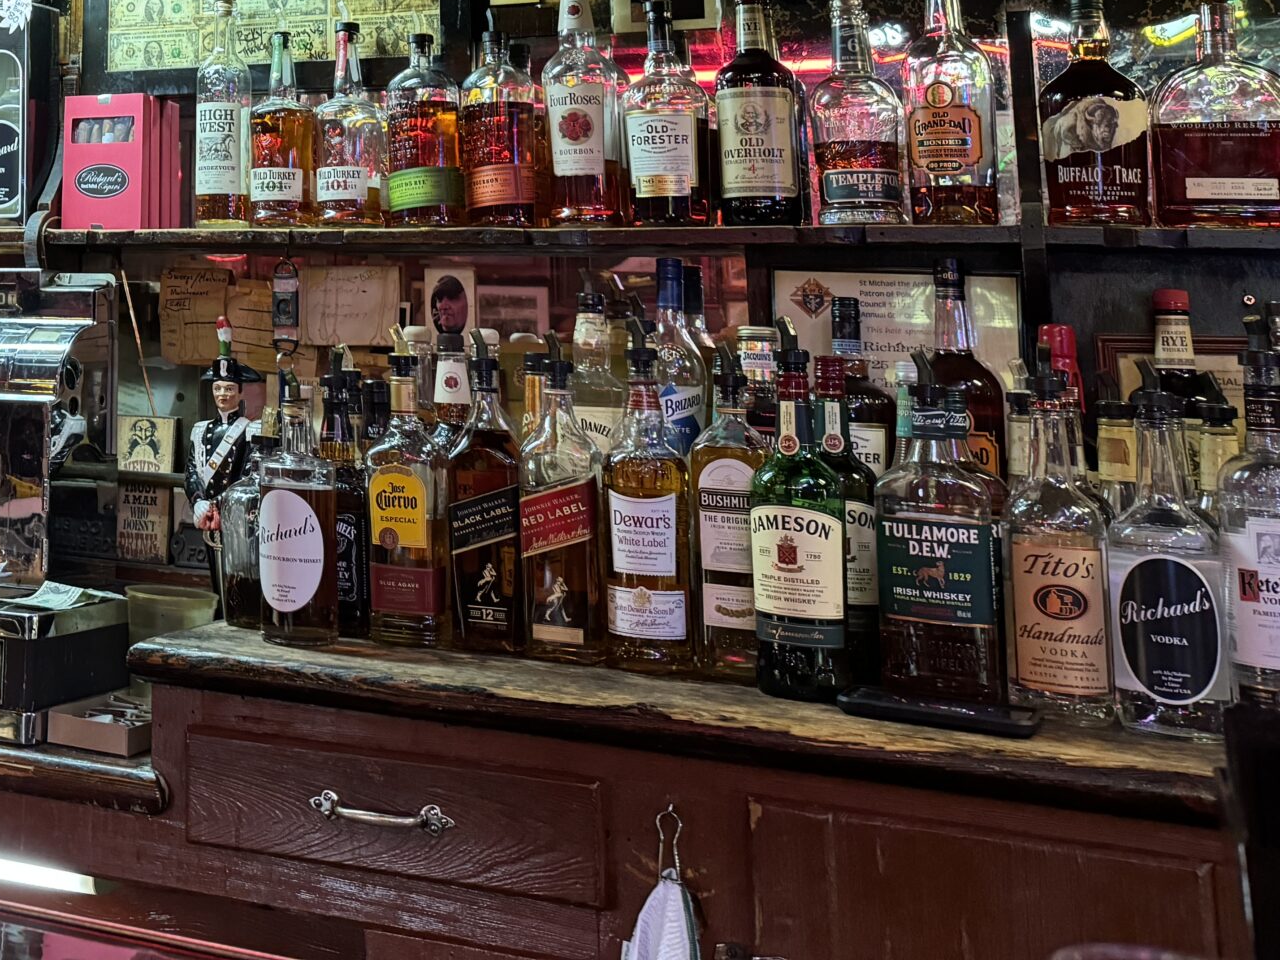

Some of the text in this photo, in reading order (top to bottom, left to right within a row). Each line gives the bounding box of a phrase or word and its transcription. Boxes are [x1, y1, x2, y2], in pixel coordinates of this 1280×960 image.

[549, 92, 601, 107] Four Roses
[200, 109, 235, 121] HIGH
[200, 122, 235, 133] WEST
[646, 124, 669, 134] OLD
[1171, 121, 1231, 130] WOODFORD
[632, 134, 689, 145] FORESTER
[740, 137, 764, 147] OLD
[923, 138, 962, 147] BONDED
[559, 148, 594, 156] BOURBON
[724, 147, 785, 159] OVERHOLT
[267, 169, 296, 180] TURKEY
[332, 168, 361, 179] TURKEY
[1057, 164, 1142, 184] BUFFALO TRACE
[259, 180, 284, 192] 101
[325, 179, 349, 191] 101
[829, 172, 899, 188] TEMPLETON
[858, 182, 883, 192] RYE
[1160, 335, 1188, 347] RYE
[664, 393, 702, 417] BRIZARD
[124, 460, 160, 472] NEVER
[125, 484, 158, 494] TRUST
[387, 482, 406, 495] Jose
[133, 495, 158, 506] MAN
[375, 489, 418, 511] Cuervo
[130, 506, 149, 519] WHO
[452, 506, 513, 529] BLACK LABEL
[521, 502, 586, 526] RED LABEL
[123, 519, 156, 532] DOESN'T
[380, 515, 417, 525] ESPECIAL
[613, 510, 671, 529] Dewar's
[751, 509, 833, 539] JAMESON
[260, 515, 315, 546] Richard's
[882, 521, 979, 544] TULLAMORE
[908, 541, 952, 559] D.E.W.
[761, 573, 821, 585] TRIPLE DISTILLED
[892, 566, 972, 581] EST. 1829
[395, 581, 420, 589] AGAVE
[765, 594, 816, 605] IRISH WHISKEY
[893, 586, 972, 602] IRISH WHISKEY
[1121, 588, 1211, 625] Richard's
[481, 608, 494, 620] 12
[1019, 622, 1104, 646] Handmade
[1150, 633, 1189, 646] VODKA
[1039, 645, 1089, 659] VODKA
